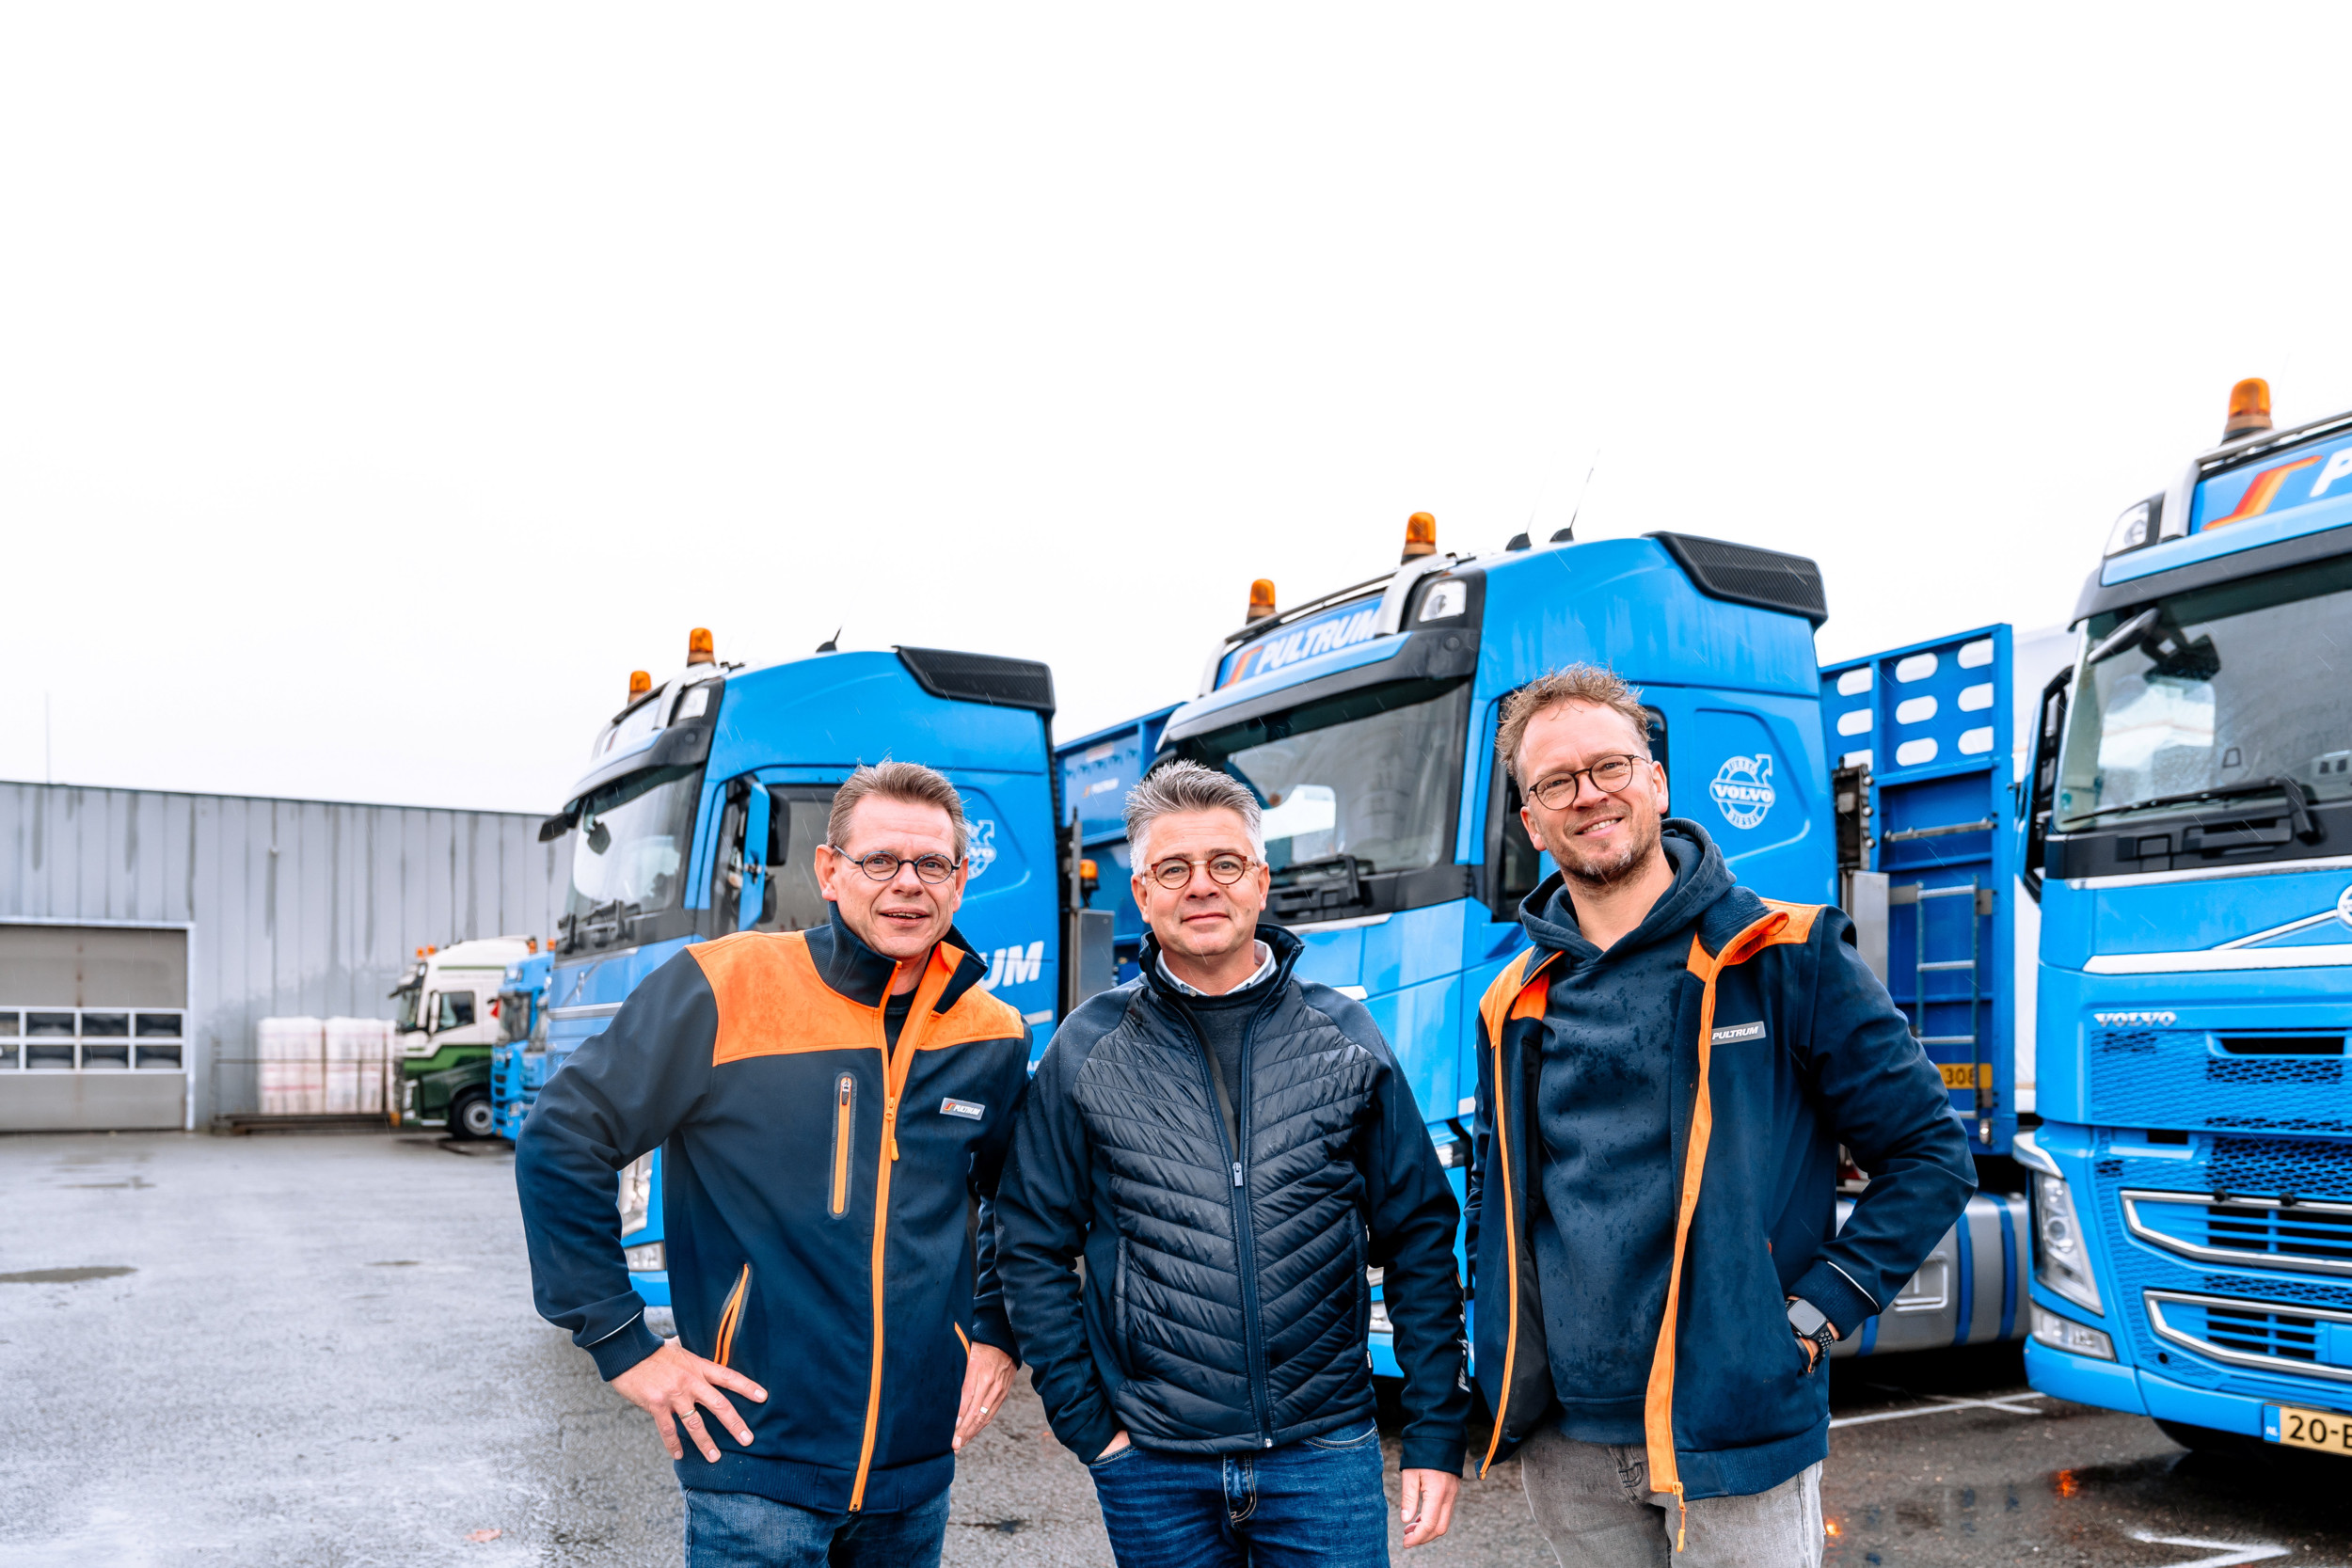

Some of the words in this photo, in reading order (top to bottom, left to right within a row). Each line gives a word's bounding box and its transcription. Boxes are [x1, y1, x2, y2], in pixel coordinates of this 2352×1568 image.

[1254, 608, 1381, 675] PULTRUM
[1713, 784, 1772, 803] VOLVO
[2093, 1011, 2176, 1028] VOLVO
[1712, 1026, 1759, 1040] PULTRUM
